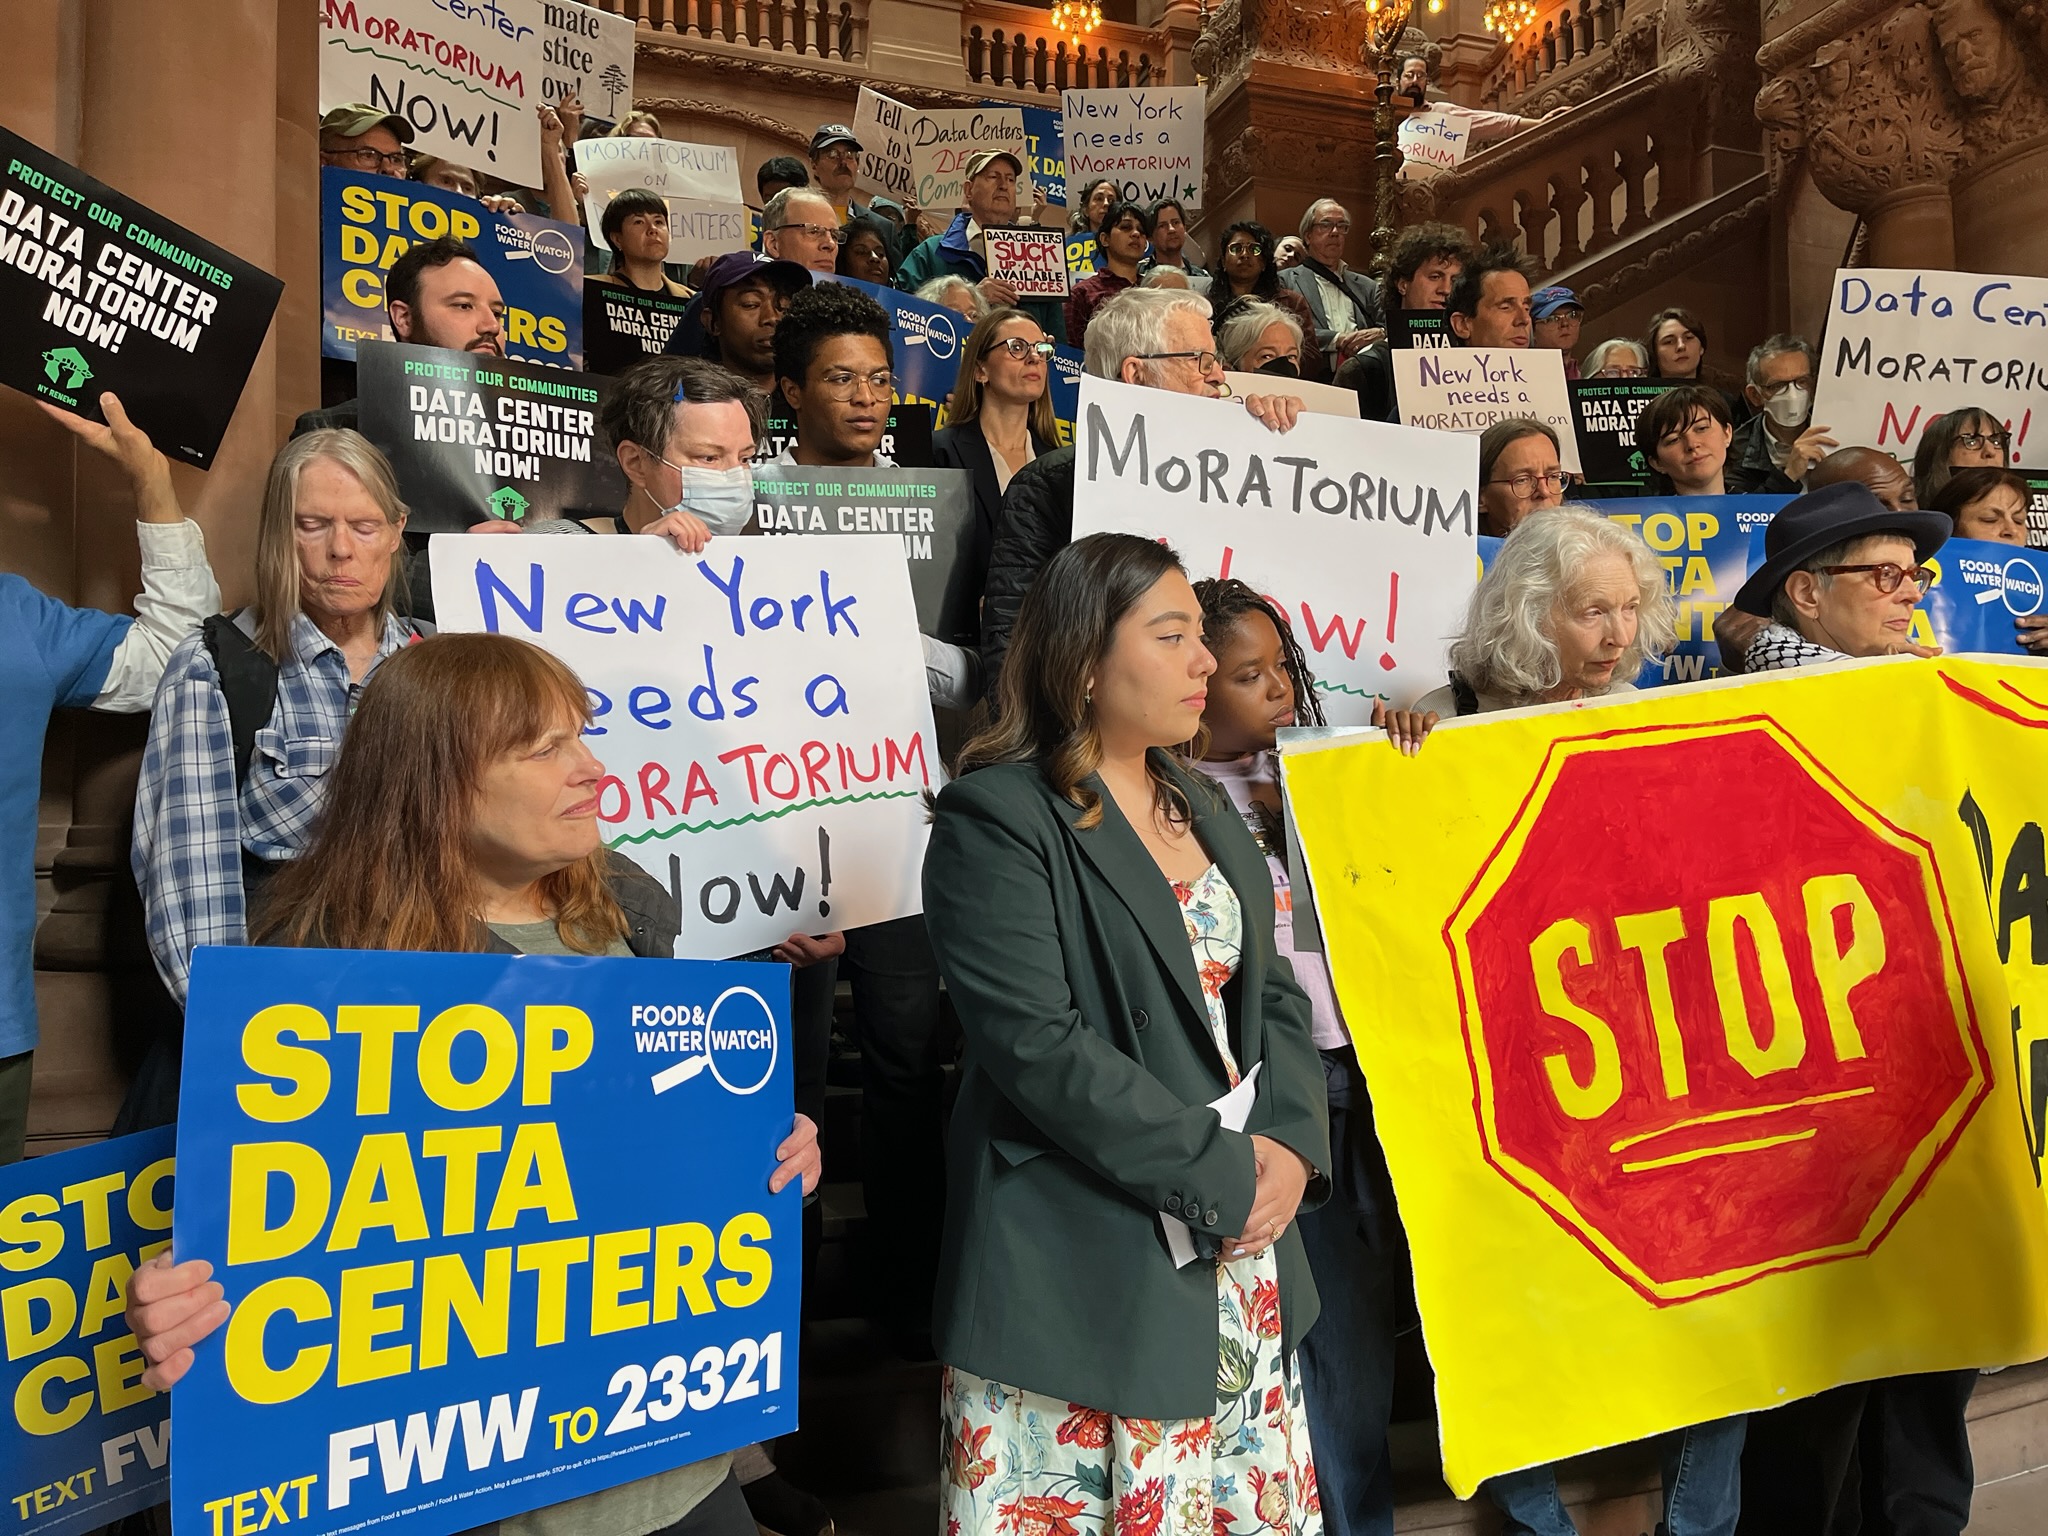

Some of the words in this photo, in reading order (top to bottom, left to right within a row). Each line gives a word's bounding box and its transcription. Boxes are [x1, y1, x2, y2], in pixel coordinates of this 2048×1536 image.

[544, 3, 600, 39] mate
[325, 0, 525, 98] MORATORIUM
[543, 41, 594, 74] stice
[370, 73, 498, 162] NOW!
[875, 98, 901, 131] Tell
[1067, 94, 1118, 119] New
[1129, 93, 1183, 120] York
[912, 115, 969, 146] Data
[970, 114, 1023, 141] Centers
[1073, 123, 1144, 148] needs
[1158, 131, 1170, 144] a
[1404, 116, 1464, 142] Center
[585, 141, 728, 173] MORATORIUM
[886, 136, 900, 159] to
[1400, 142, 1455, 166] ORIUM
[644, 173, 667, 186] ON
[1043, 157, 1066, 179] DA
[1070, 154, 1191, 175] MORATORIUM
[7, 158, 86, 210] PROTECT
[88, 202, 123, 232] OUR
[126, 223, 234, 290] COMMUNITIES
[341, 186, 480, 241] STOP
[670, 212, 743, 241] ENTERS
[0, 189, 85, 260] DATA
[96, 242, 218, 326] CENTER
[341, 224, 433, 271] DA
[496, 233, 531, 251] WATER
[534, 243, 571, 260] WATCH
[994, 241, 1059, 263] SUCK
[1066, 240, 1098, 261] OP
[993, 269, 1064, 282] AVAILABLE
[999, 260, 1017, 271] UP
[1022, 261, 1053, 272] ALL
[0, 225, 202, 354] MORATORIUM
[602, 290, 635, 304] PROTECT
[637, 298, 654, 308] OUR
[1008, 280, 1064, 293] SOURCES
[1840, 275, 1953, 318] Data
[1972, 282, 2048, 327] Cen
[42, 291, 129, 354] NOW!
[606, 302, 646, 324] DATA
[650, 312, 681, 329] CEN
[610, 317, 674, 342] MORATO
[1408, 319, 1442, 328] PROTECT
[335, 325, 377, 341] TEXT
[641, 338, 665, 355] NO
[898, 318, 925, 335] WATER
[927, 328, 953, 345] WATCH
[1412, 333, 1452, 349] DATA
[1055, 363, 1080, 376] WATER
[1419, 355, 1472, 387] New
[1473, 354, 1528, 385] York
[1835, 336, 2048, 392] MORATORI
[37, 383, 49, 395] NY
[49, 388, 78, 407] RENEWS
[404, 360, 470, 382] PROTECT
[475, 370, 504, 387] OUR
[509, 375, 598, 403] COMMUNITIES
[1447, 383, 1510, 406] needs
[1518, 390, 1531, 404] a
[1577, 387, 1612, 397] PROTECT
[1614, 387, 1630, 395] OUR
[409, 385, 487, 419] DATA
[497, 396, 595, 437] CENTER
[1547, 414, 1569, 426] on
[1581, 400, 1623, 417] DATA
[413, 414, 592, 463] MORATORIUM
[1585, 415, 1640, 433] MORAT
[474, 448, 540, 482] NOW!
[1086, 402, 1473, 538] MORATORIUM
[752, 481, 810, 496] PROTECT
[815, 483, 843, 496] OUR
[848, 484, 937, 498] COMMUNITIES
[757, 503, 827, 531] DATA
[837, 506, 935, 533] CENTER
[475, 557, 666, 635] New
[696, 555, 860, 638] York
[1963, 572, 2002, 587] WATER
[2005, 577, 2040, 596] WATCH
[578, 644, 759, 736] eeds
[805, 673, 850, 719] a
[596, 731, 931, 824] ORATORIUM
[1529, 872, 1886, 1121] STOP
[635, 1030, 704, 1053] WATER
[711, 1029, 772, 1051] WATCH
[236, 1003, 595, 1123] STOP
[227, 1121, 578, 1266] DATA
[0, 1156, 176, 1272] STO
[1, 1239, 172, 1362] DA
[225, 1211, 774, 1405] CENTERS
[204, 1475, 318, 1536] TEXT
[327, 1387, 540, 1510] FWW
[548, 1406, 600, 1451] TO
[604, 1331, 783, 1437] 23321
[12, 1467, 97, 1521] TEXT
[102, 1419, 171, 1486] FW
[338, 1521, 366, 1534] messages
[381, 1512, 395, 1522] Food
[401, 1506, 417, 1516] Water
[417, 1501, 434, 1512] Watch
[439, 1496, 453, 1505] Food
[458, 1490, 474, 1500] Water
[551, 1465, 566, 1474] STOP
[654, 1436, 670, 1447] privacy
